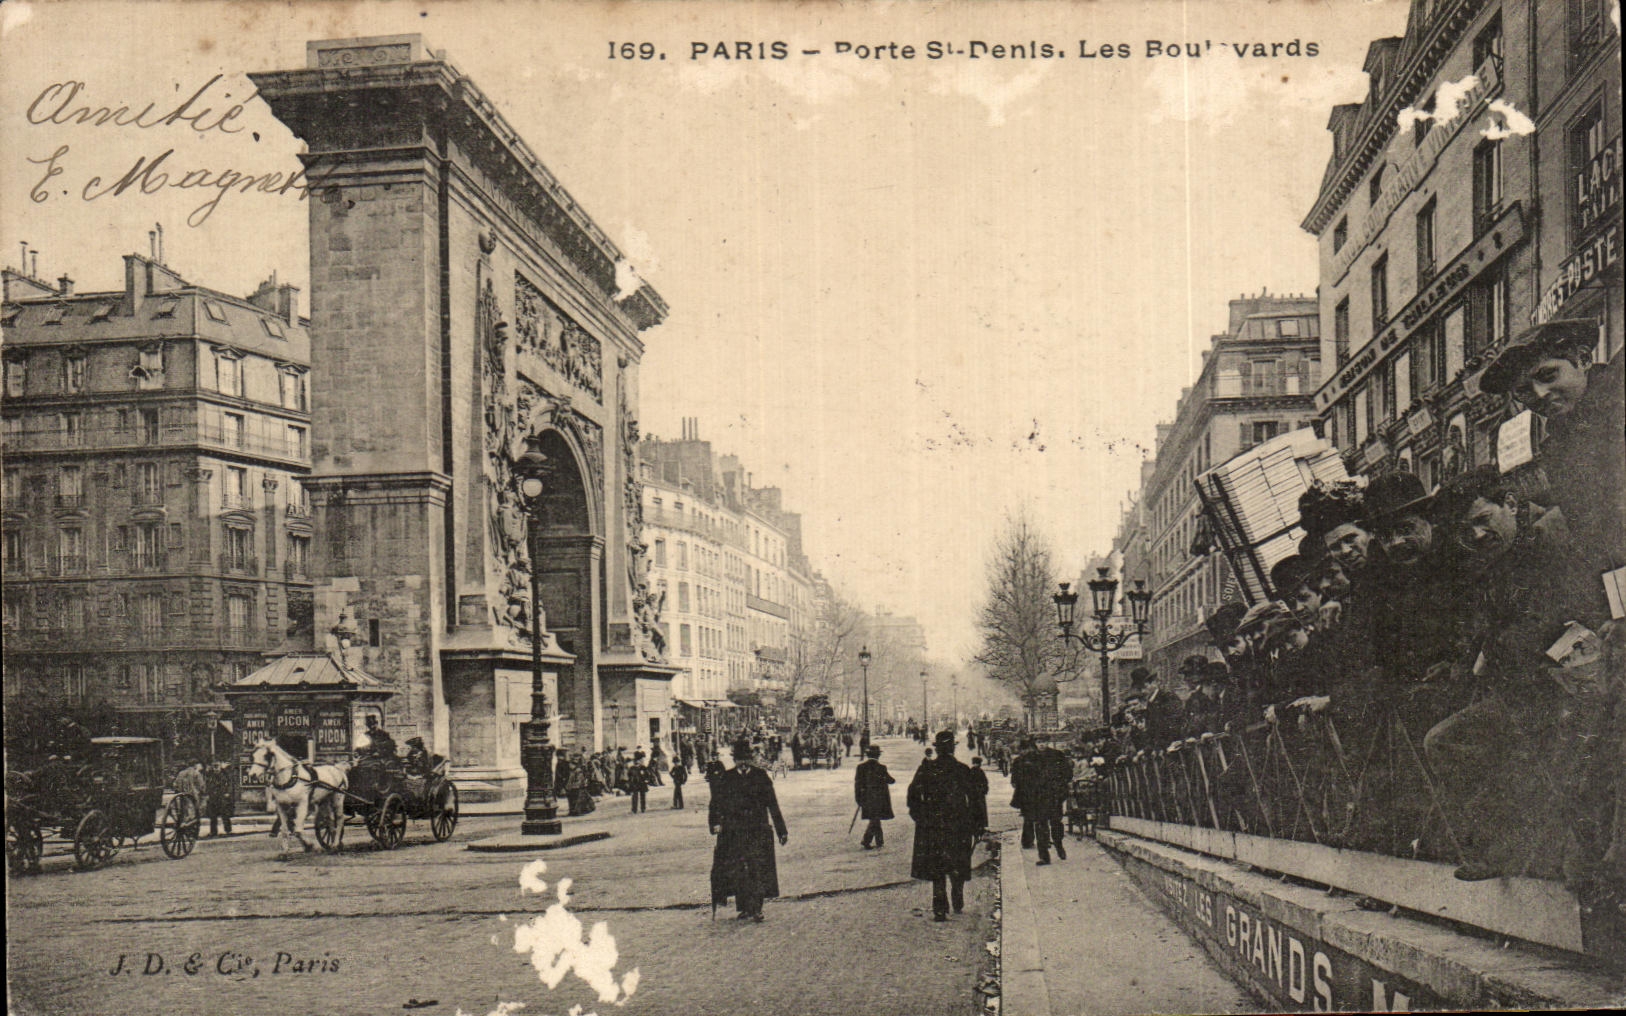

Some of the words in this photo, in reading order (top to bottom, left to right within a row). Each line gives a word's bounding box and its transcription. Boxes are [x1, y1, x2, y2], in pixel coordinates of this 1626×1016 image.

[26, 145, 69, 203] E.
[277, 715, 310, 727] PICON
[318, 728, 347, 743] PICON
[1194, 889, 1213, 928] LES
[1226, 905, 1334, 1012] GRANDS
